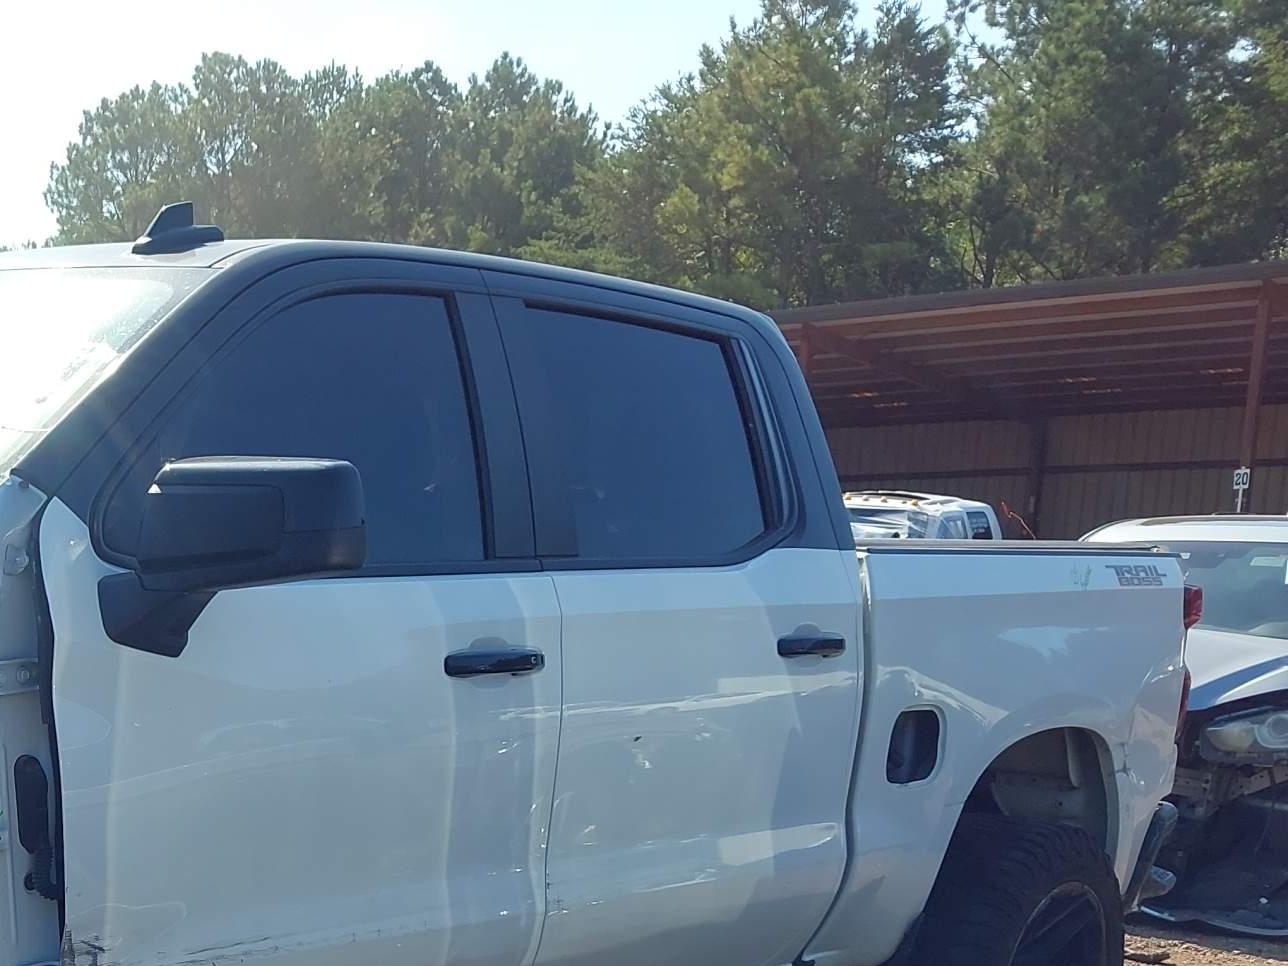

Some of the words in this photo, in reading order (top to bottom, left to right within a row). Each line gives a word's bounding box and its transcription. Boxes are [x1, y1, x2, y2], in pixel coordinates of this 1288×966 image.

[1234, 471, 1249, 486] 20
[1105, 565, 1167, 577] TRAIL
[1118, 576, 1163, 587] BOSS
